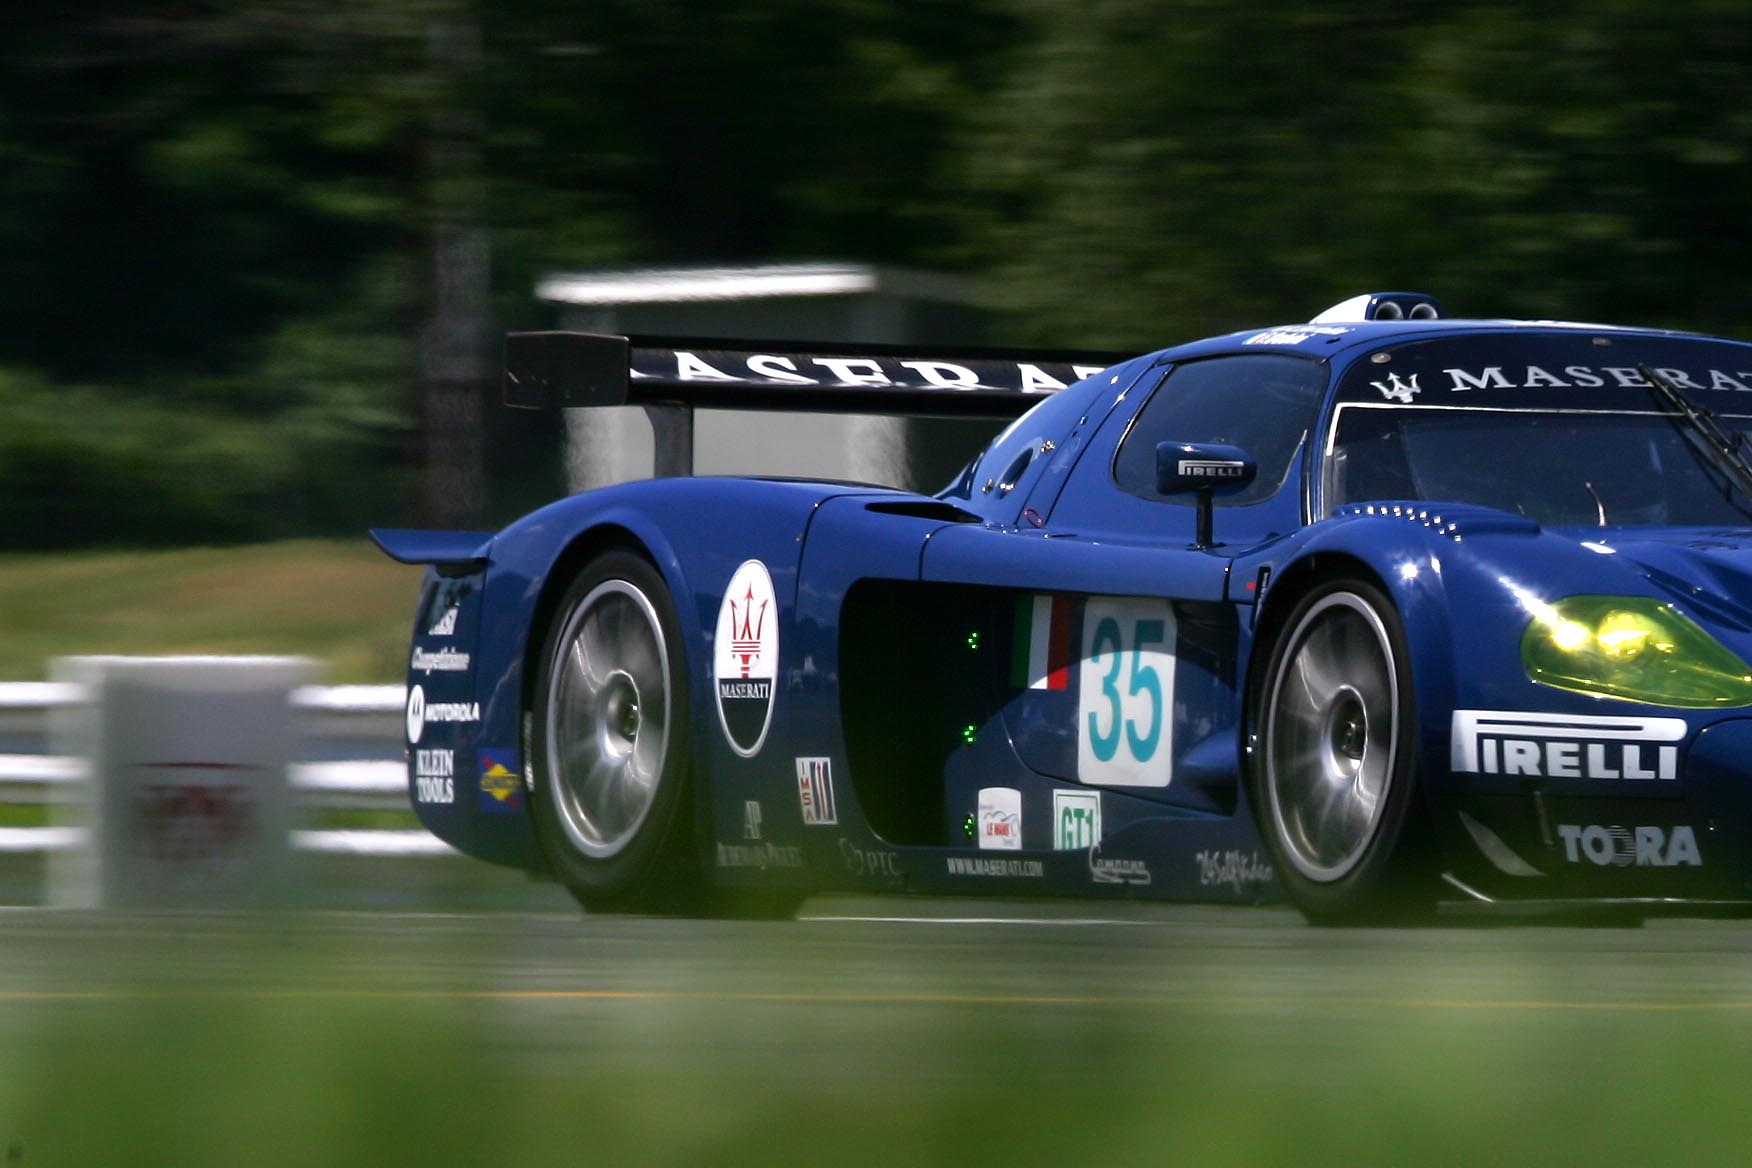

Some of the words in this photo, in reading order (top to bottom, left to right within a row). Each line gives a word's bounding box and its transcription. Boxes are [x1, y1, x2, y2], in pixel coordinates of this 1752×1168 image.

[1178, 460, 1244, 477] PIRELLI
[720, 683, 769, 699] MASERATI
[1088, 617, 1164, 762] 35
[425, 702, 480, 722] MOTOROLA
[1451, 710, 1688, 780] PIRELLI
[416, 749, 454, 776] KLEIN
[417, 776, 454, 803] TOOLS
[1061, 806, 1094, 851] GT1
[946, 857, 1044, 877] WWW.MASERATI.COM
